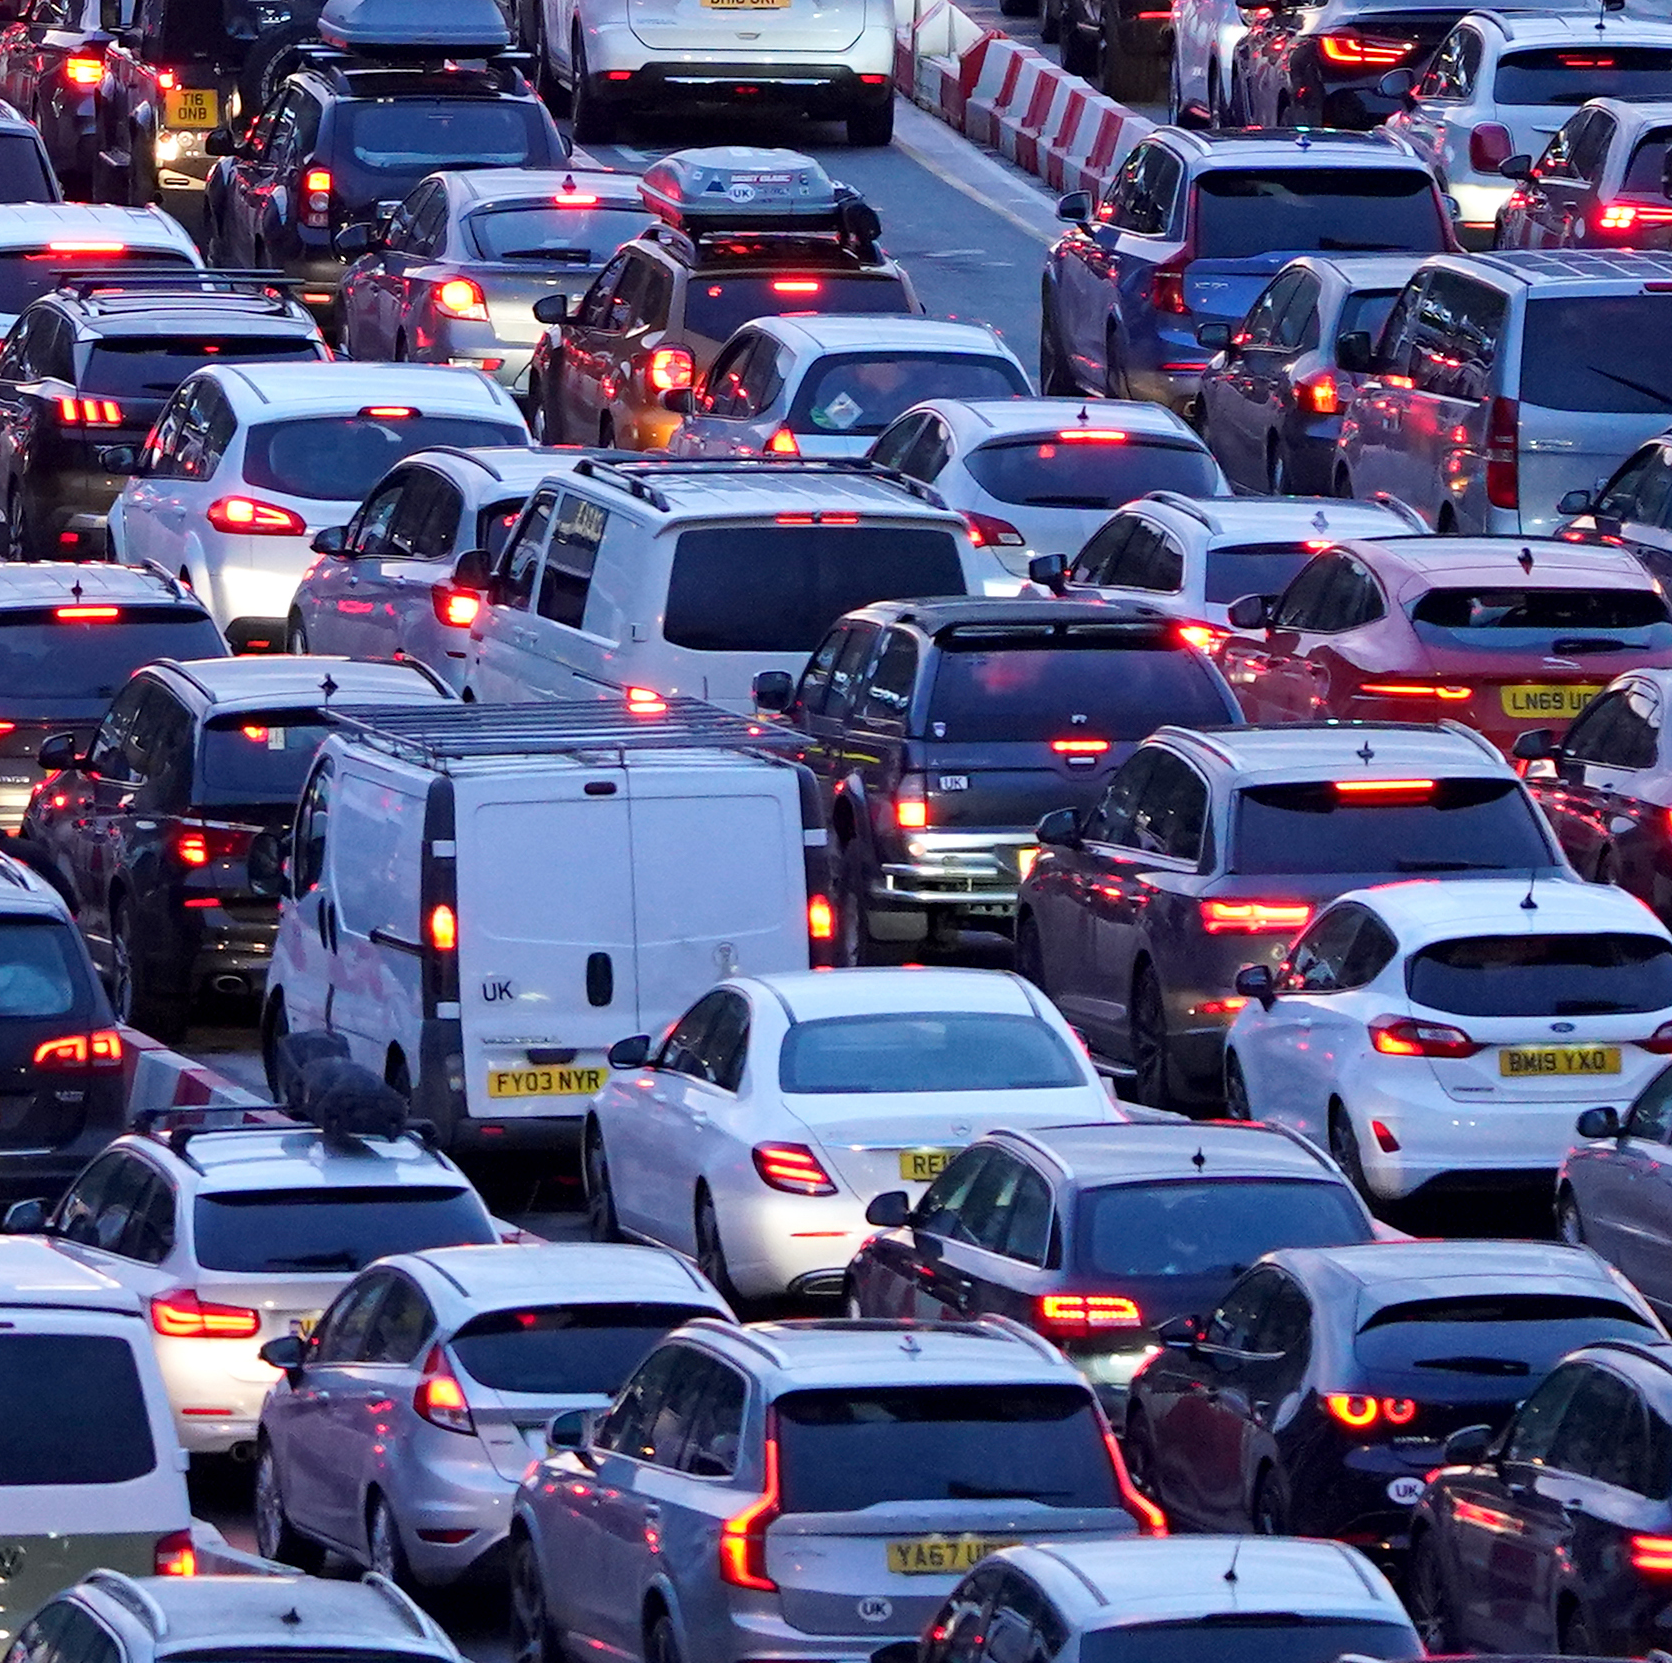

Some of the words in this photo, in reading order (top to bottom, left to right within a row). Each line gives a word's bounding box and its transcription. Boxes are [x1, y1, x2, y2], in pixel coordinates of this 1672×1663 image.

[182, 93, 204, 104] T16
[733, 189, 750, 198] UK
[1512, 690, 1564, 710] LN69
[943, 776, 963, 789] UK
[482, 981, 514, 1003] UK
[496, 1071, 552, 1094] FY03
[558, 1069, 601, 1092] NYR
[1395, 1483, 1418, 1498] UK
[899, 1543, 958, 1567] YA67
[862, 1602, 887, 1616] UK
